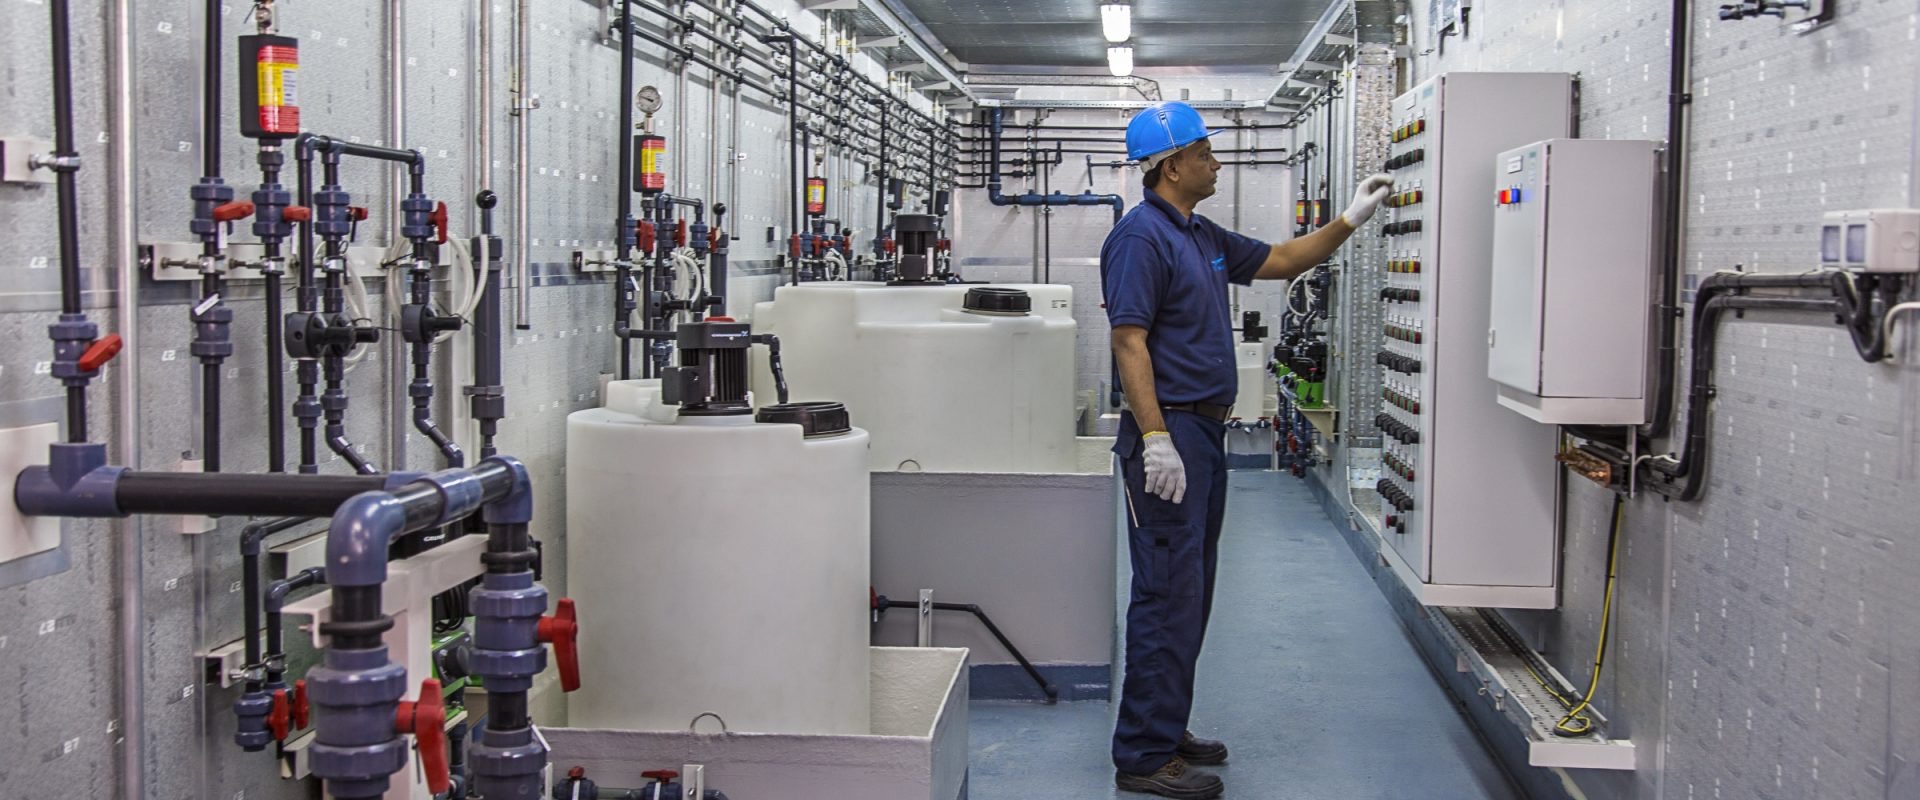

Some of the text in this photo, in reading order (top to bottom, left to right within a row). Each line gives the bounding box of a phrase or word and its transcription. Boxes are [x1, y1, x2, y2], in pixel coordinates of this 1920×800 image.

[157, 22, 173, 34] 27
[178, 141, 192, 152] 27
[29, 256, 48, 269] 27
[161, 349, 176, 361] 27
[163, 578, 178, 592] 27
[38, 619, 56, 636] 27
[63, 737, 80, 754] 27
